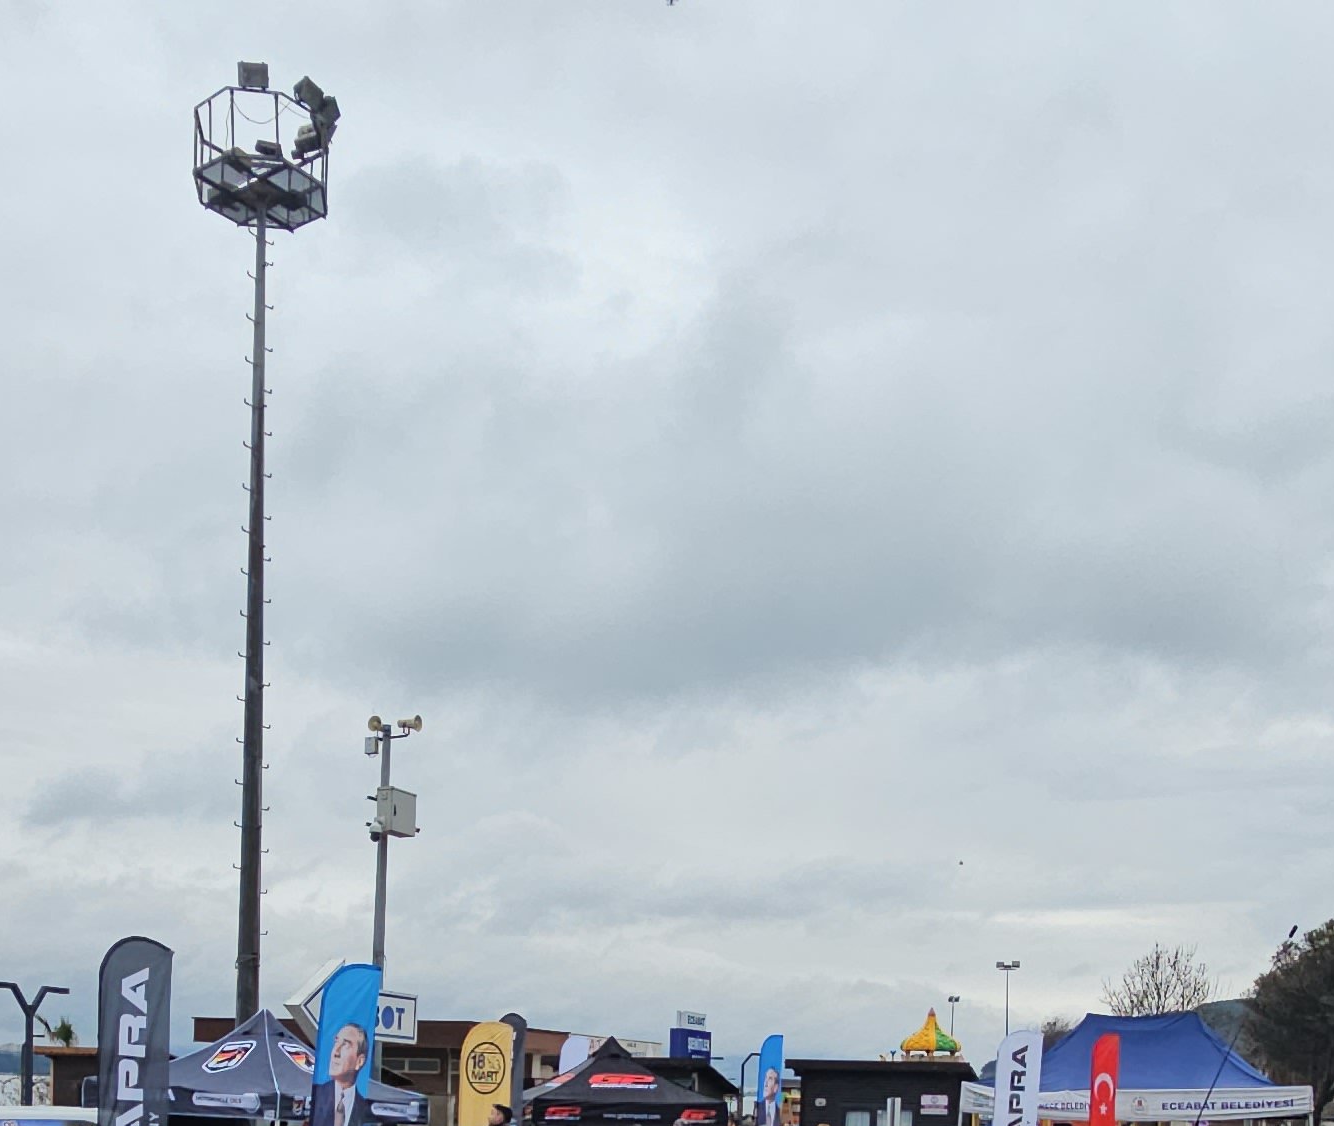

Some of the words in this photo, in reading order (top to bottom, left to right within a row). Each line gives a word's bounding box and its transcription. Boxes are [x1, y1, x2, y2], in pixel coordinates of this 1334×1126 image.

[471, 1053, 486, 1070] 18
[1161, 1101, 1216, 1111] ECEABAT
[1221, 1098, 1294, 1110] BELEDİYESİ
